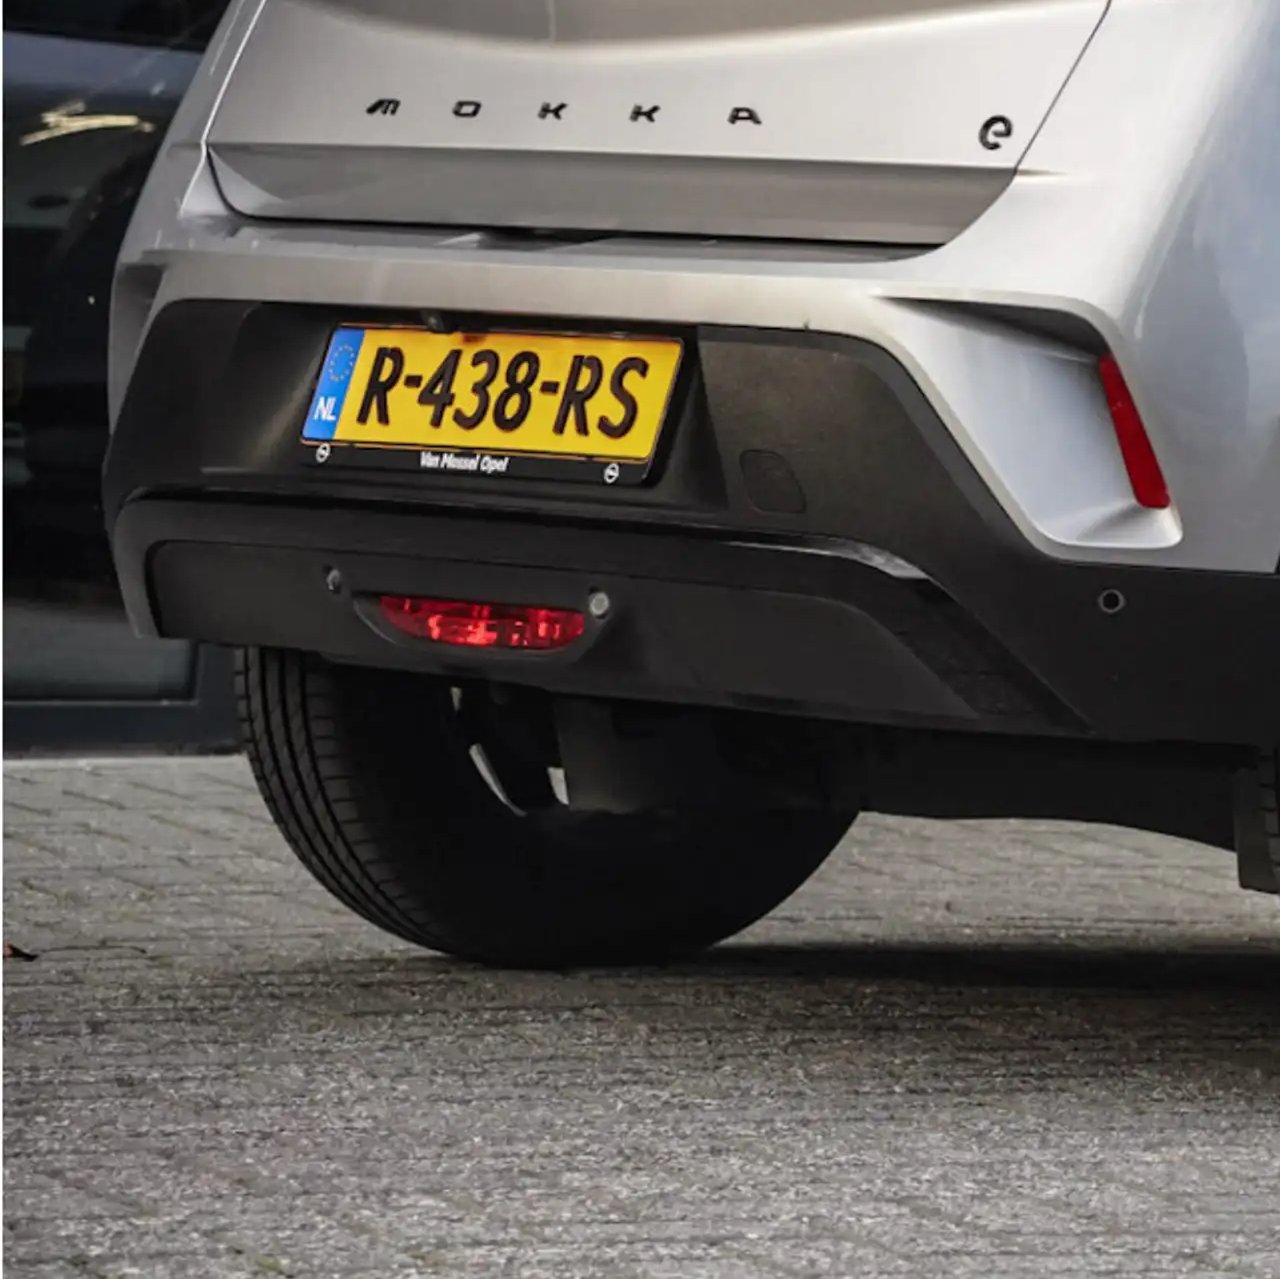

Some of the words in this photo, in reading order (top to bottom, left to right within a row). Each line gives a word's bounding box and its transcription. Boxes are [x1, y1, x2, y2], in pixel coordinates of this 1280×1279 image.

[365, 98, 762, 125] MOKKA
[357, 346, 650, 439] R-438-RS
[313, 396, 337, 421] NL
[420, 451, 440, 468] Van
[440, 453, 480, 471] Mossel
[480, 456, 510, 474] Opel
